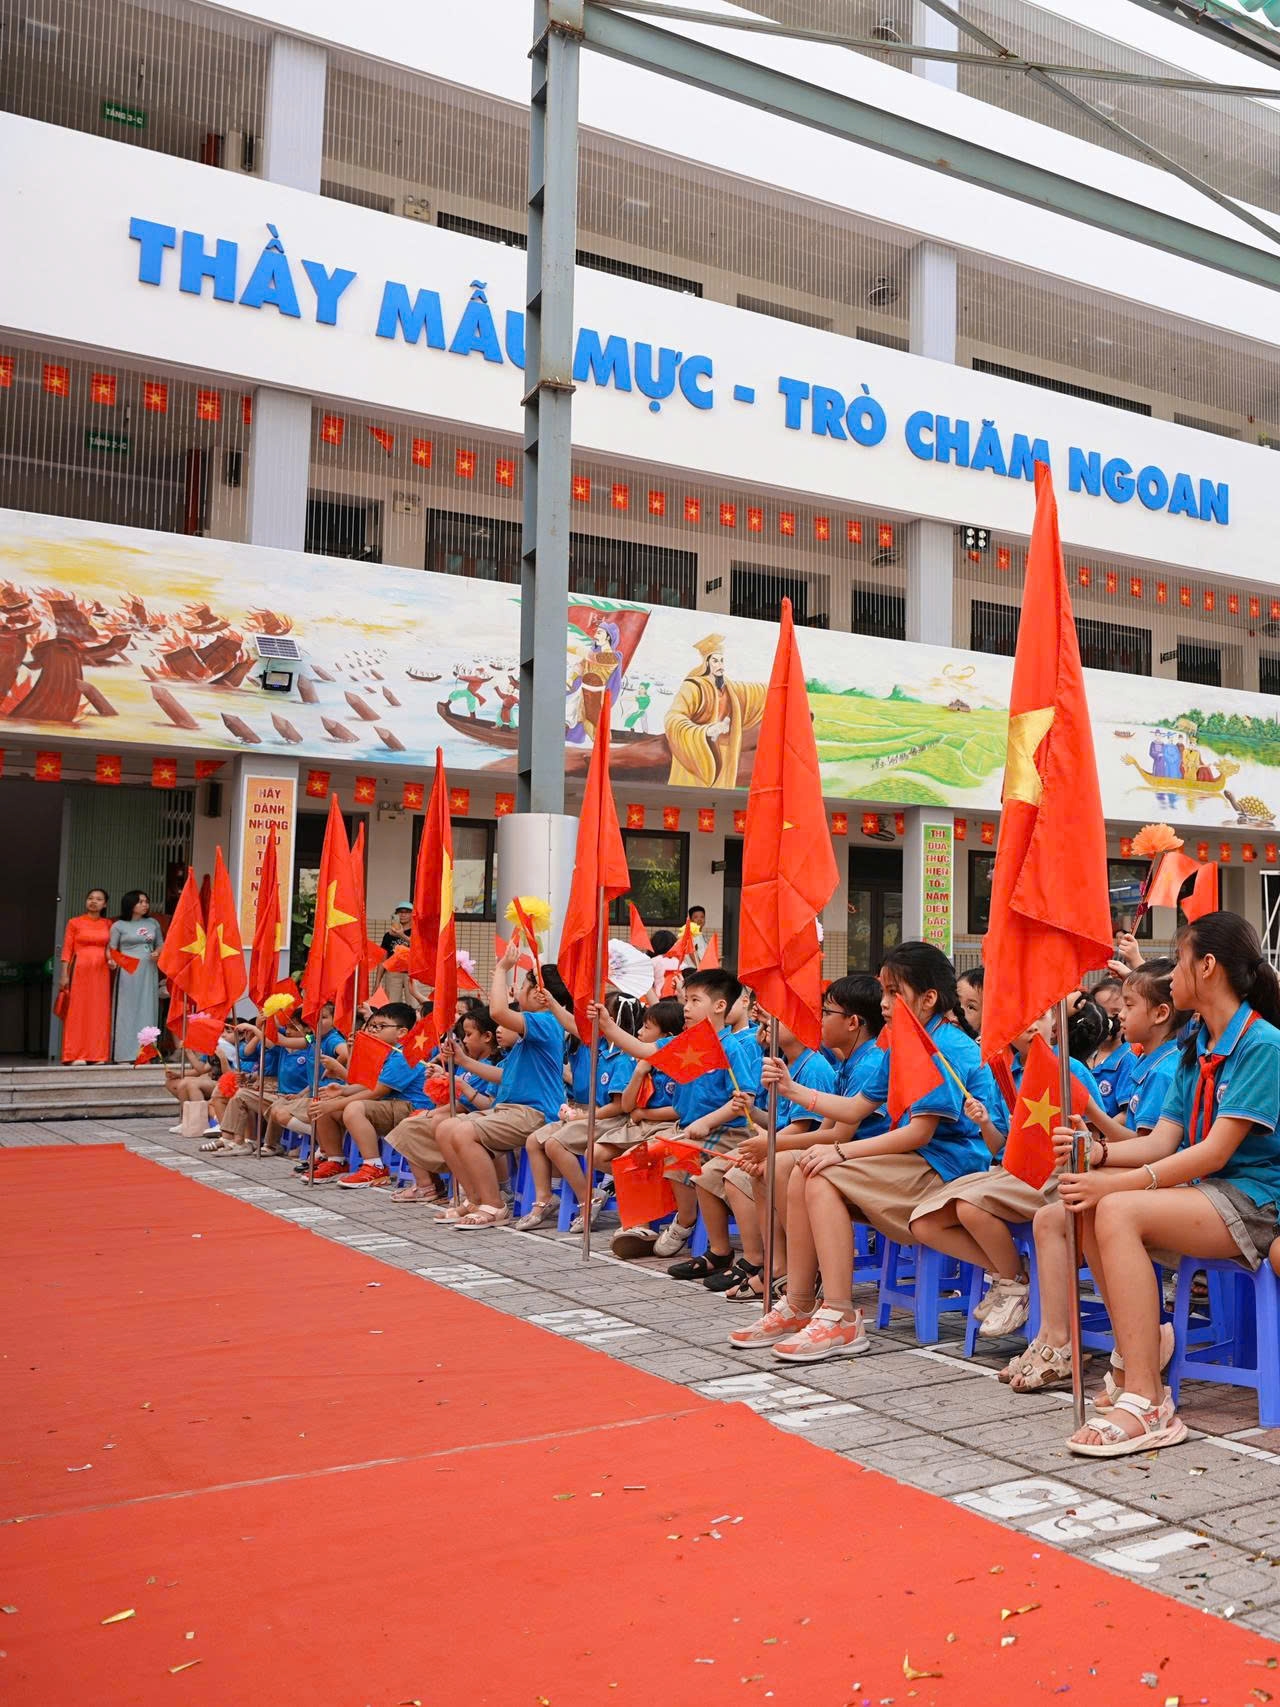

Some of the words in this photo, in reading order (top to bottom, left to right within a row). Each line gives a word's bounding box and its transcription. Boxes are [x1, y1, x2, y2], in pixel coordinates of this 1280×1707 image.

[129, 217, 357, 325] THẦY
[572, 327, 714, 412] MỰC
[778, 376, 887, 447] TRÒ
[905, 410, 1051, 483] CHĂM
[1068, 446, 1230, 526] NGOAN
[953, 1479, 1213, 1574] 1A5
